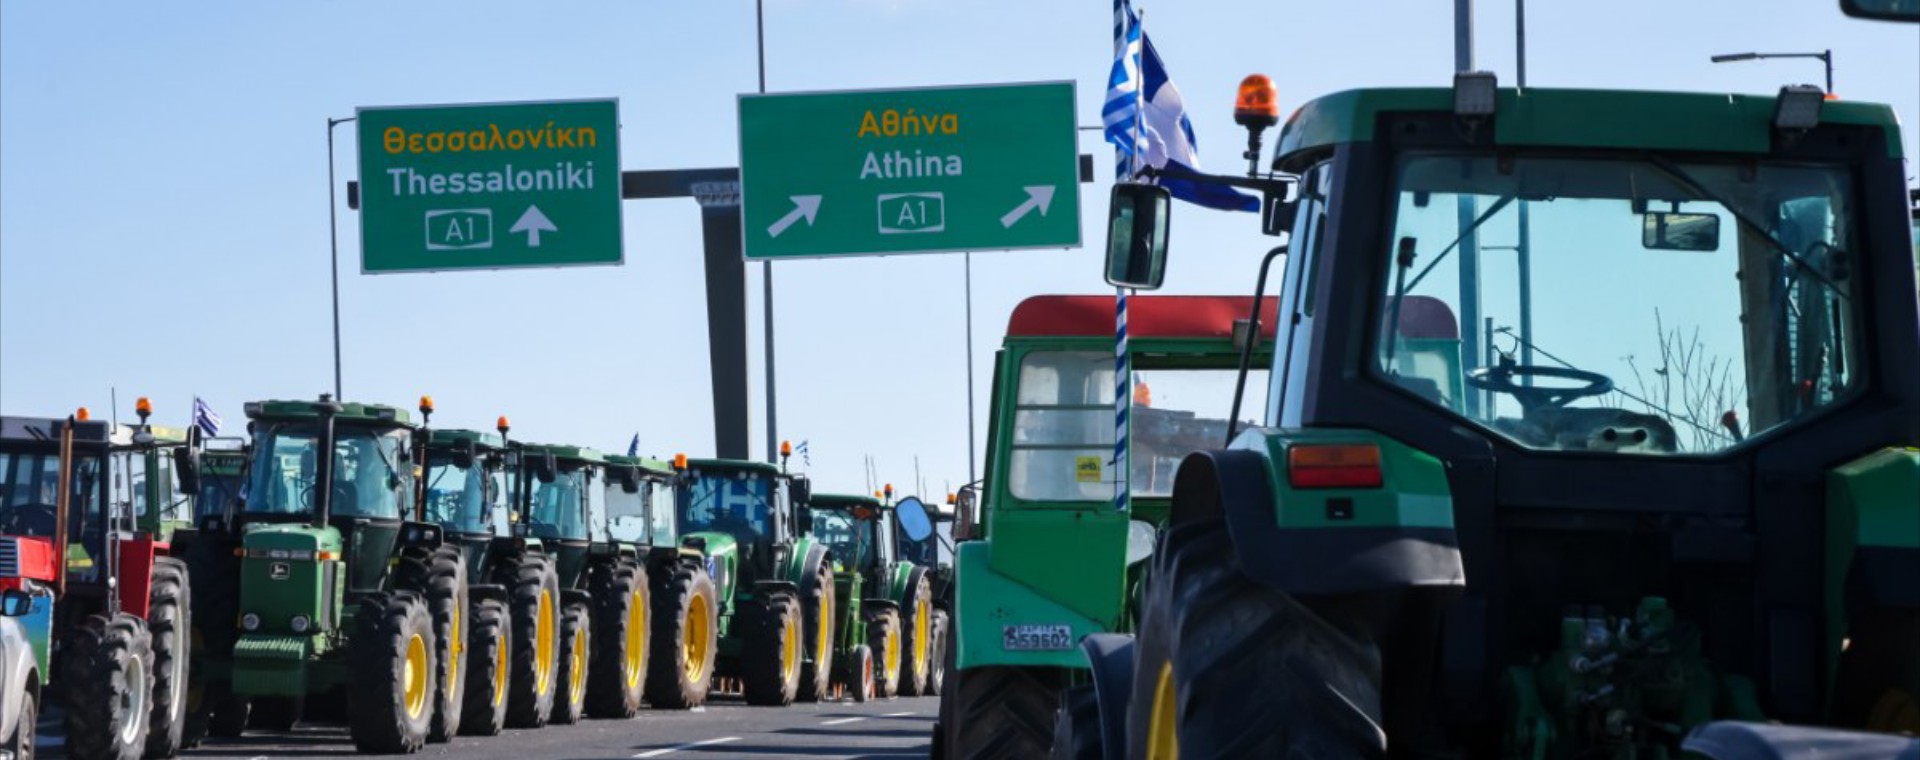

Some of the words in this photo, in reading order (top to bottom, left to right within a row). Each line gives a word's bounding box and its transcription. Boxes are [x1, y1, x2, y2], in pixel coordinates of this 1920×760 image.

[858, 108, 958, 137] Αθήνα
[383, 121, 596, 154] Θεσσαλονίκη
[860, 149, 961, 178] Athina
[387, 161, 594, 196] Thessaloniki
[897, 200, 926, 226] A1
[445, 217, 475, 242] A1
